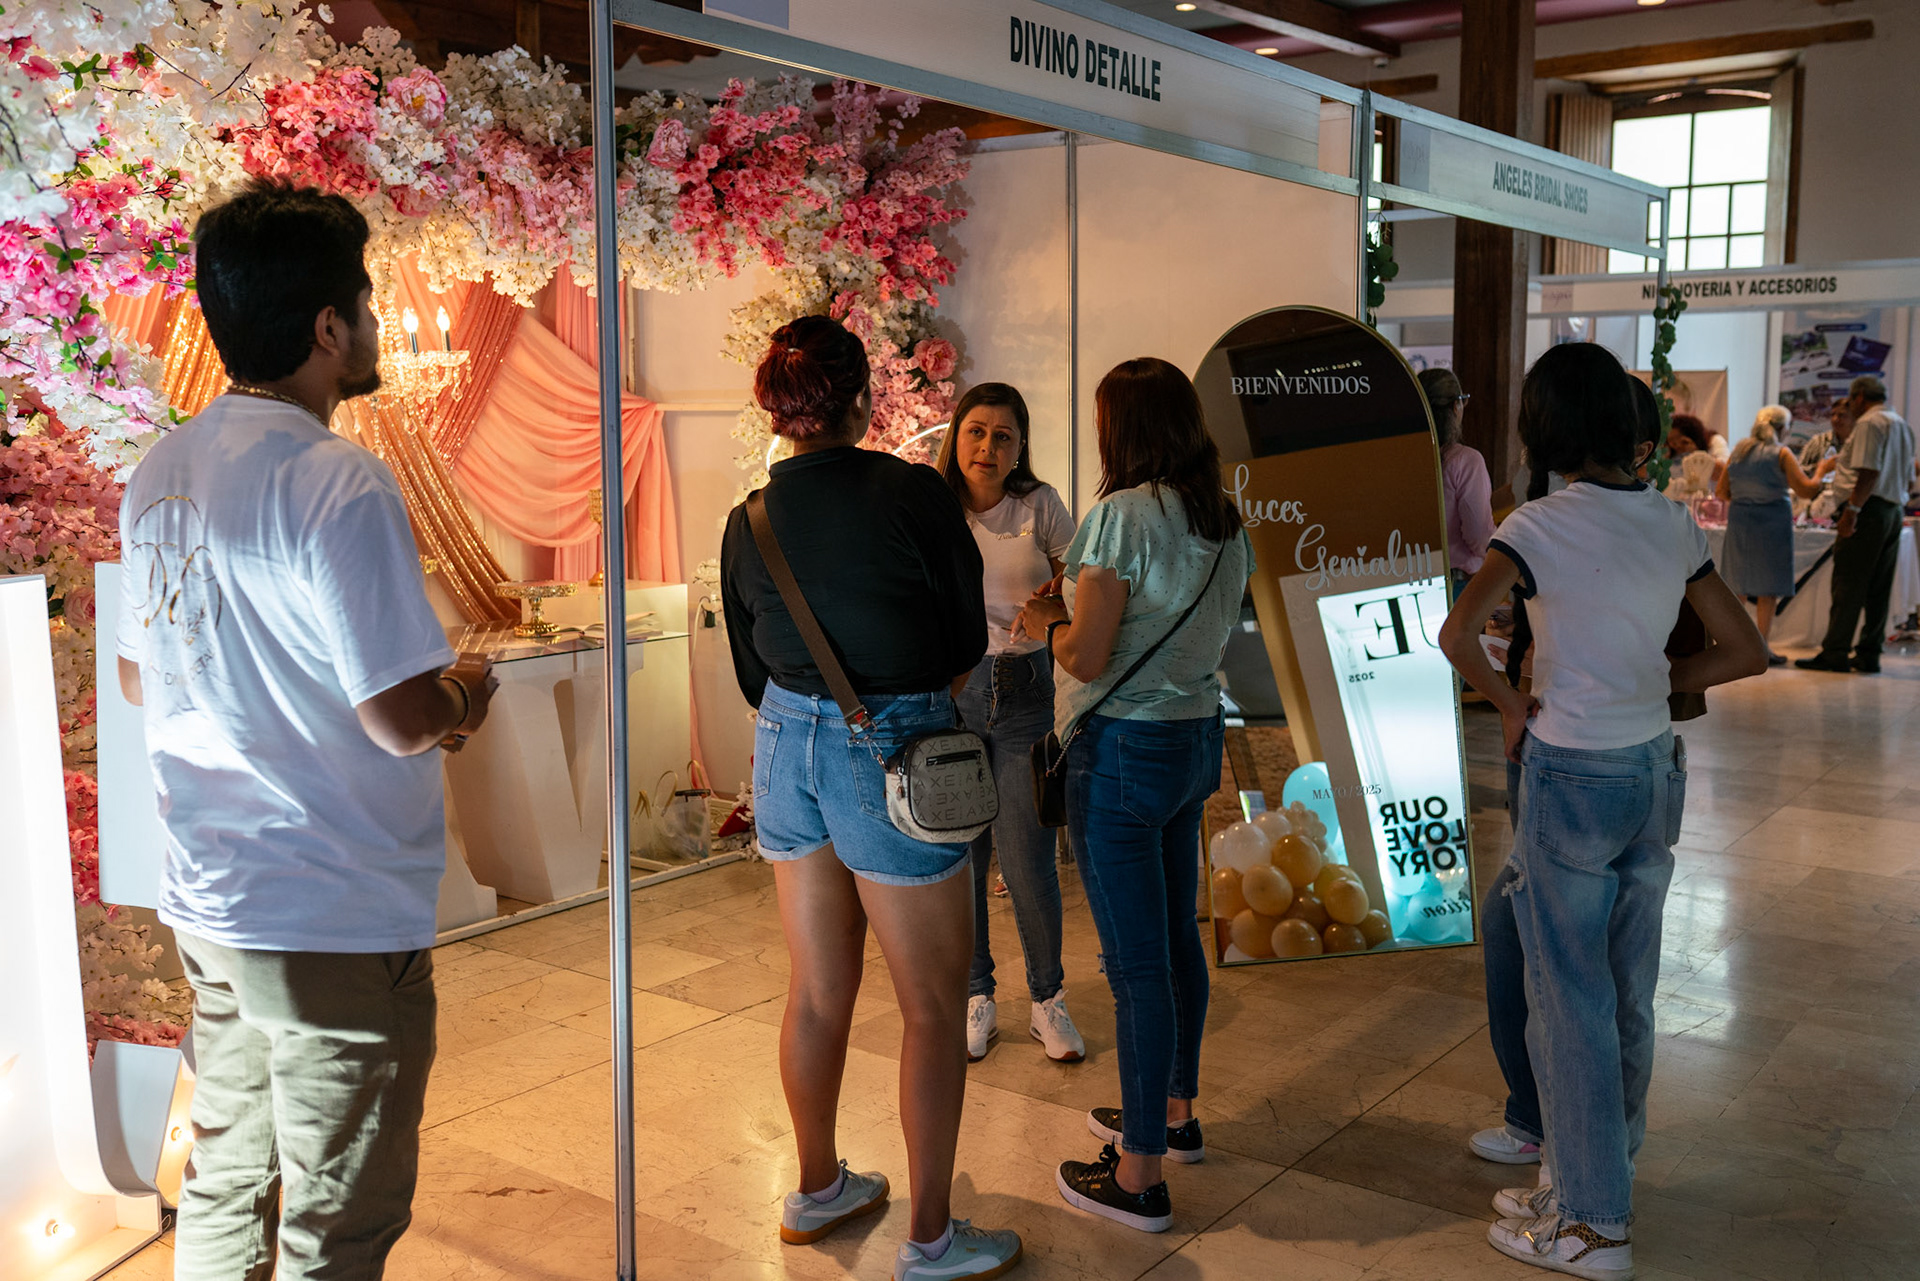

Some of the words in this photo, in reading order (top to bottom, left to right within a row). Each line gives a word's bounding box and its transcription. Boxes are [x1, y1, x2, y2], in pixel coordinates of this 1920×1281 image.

[1010, 16, 1079, 79] DIVINO
[1085, 39, 1161, 102] DETALLE
[1492, 161, 1533, 199] ANGELES
[1534, 174, 1562, 208] BRIDAL
[1564, 182, 1588, 215] SHOES
[1736, 281, 1746, 297] Y
[1749, 276, 1838, 296] ACCESORIOS
[1231, 376, 1371, 396] BIENVENIDOS
[1222, 463, 1308, 528] Luces
[1356, 784, 1382, 797] 2025
